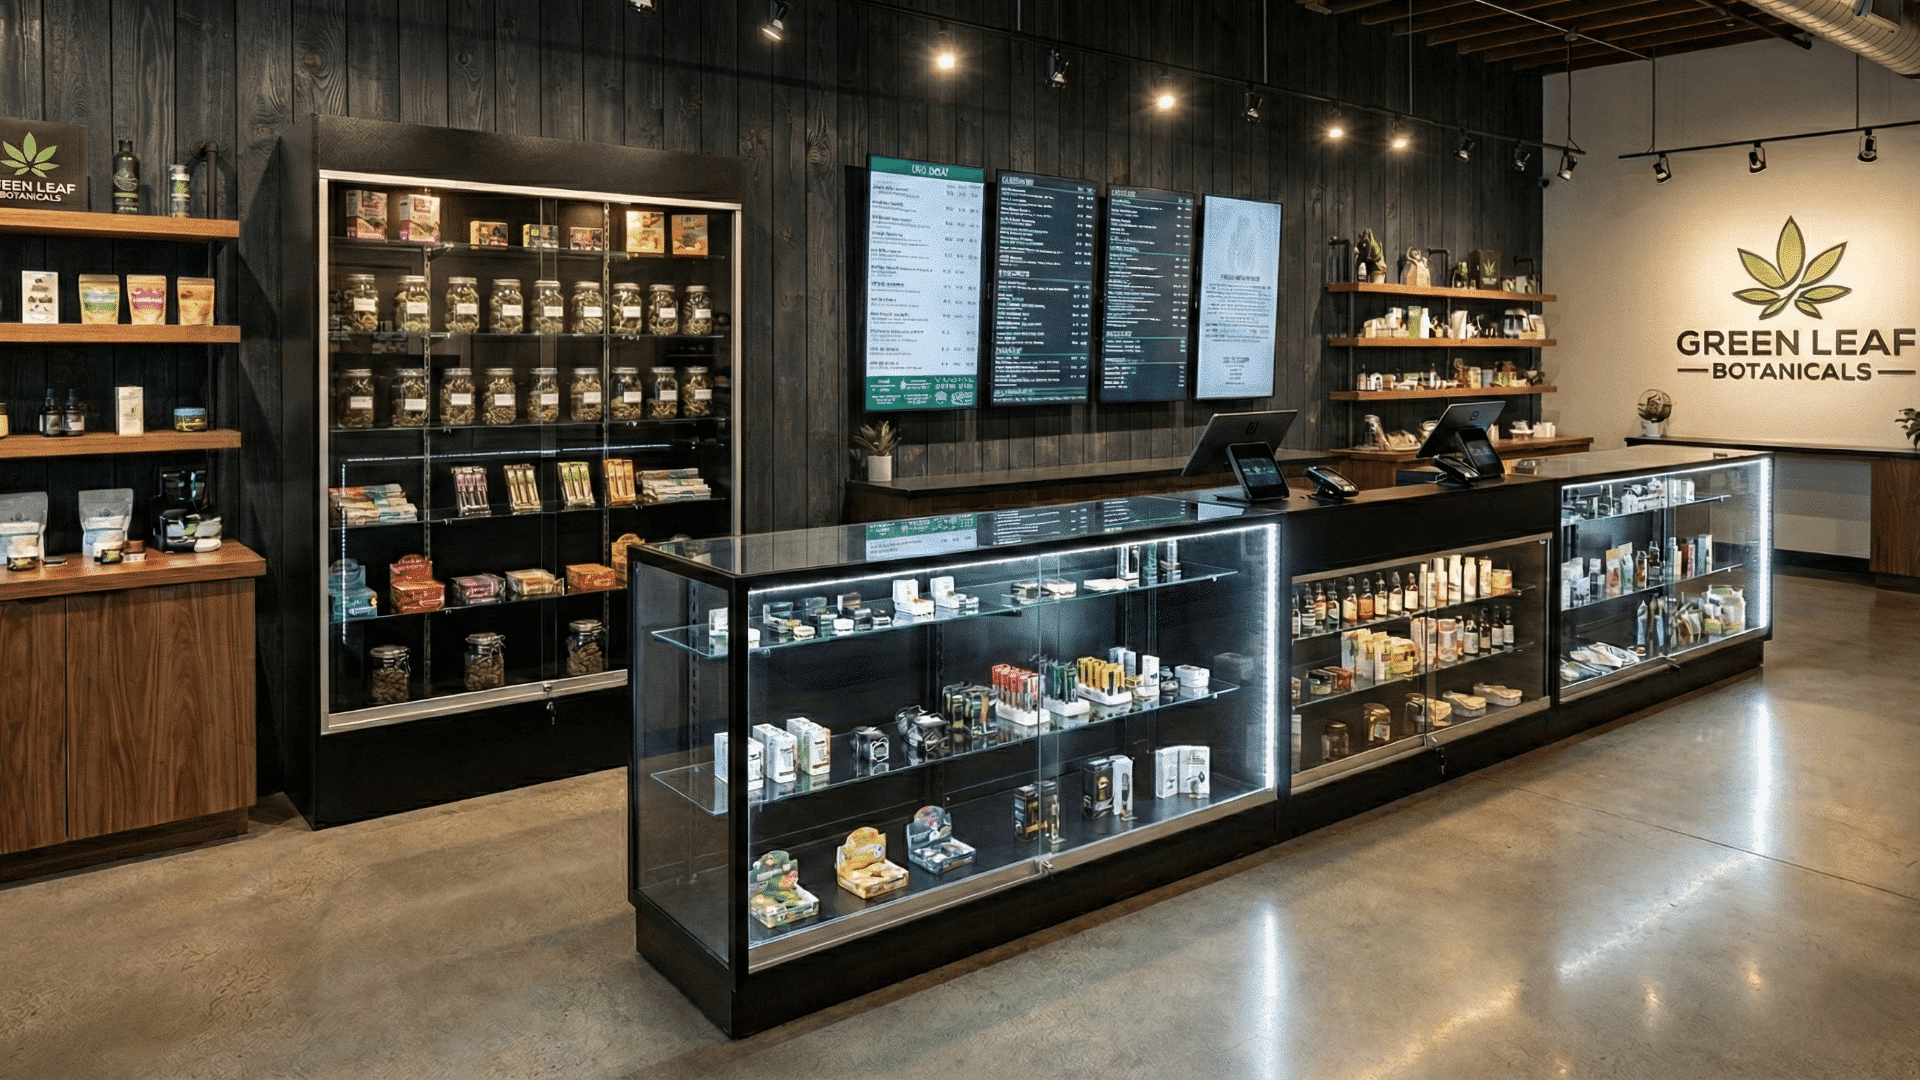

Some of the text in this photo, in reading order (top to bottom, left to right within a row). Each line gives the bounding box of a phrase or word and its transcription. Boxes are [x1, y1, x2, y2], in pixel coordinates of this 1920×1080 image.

[0, 179, 76, 195] EEN LEAF
[1676, 328, 1917, 356] GREEN LEAF
[1712, 362, 1872, 381] BOTANICALS
